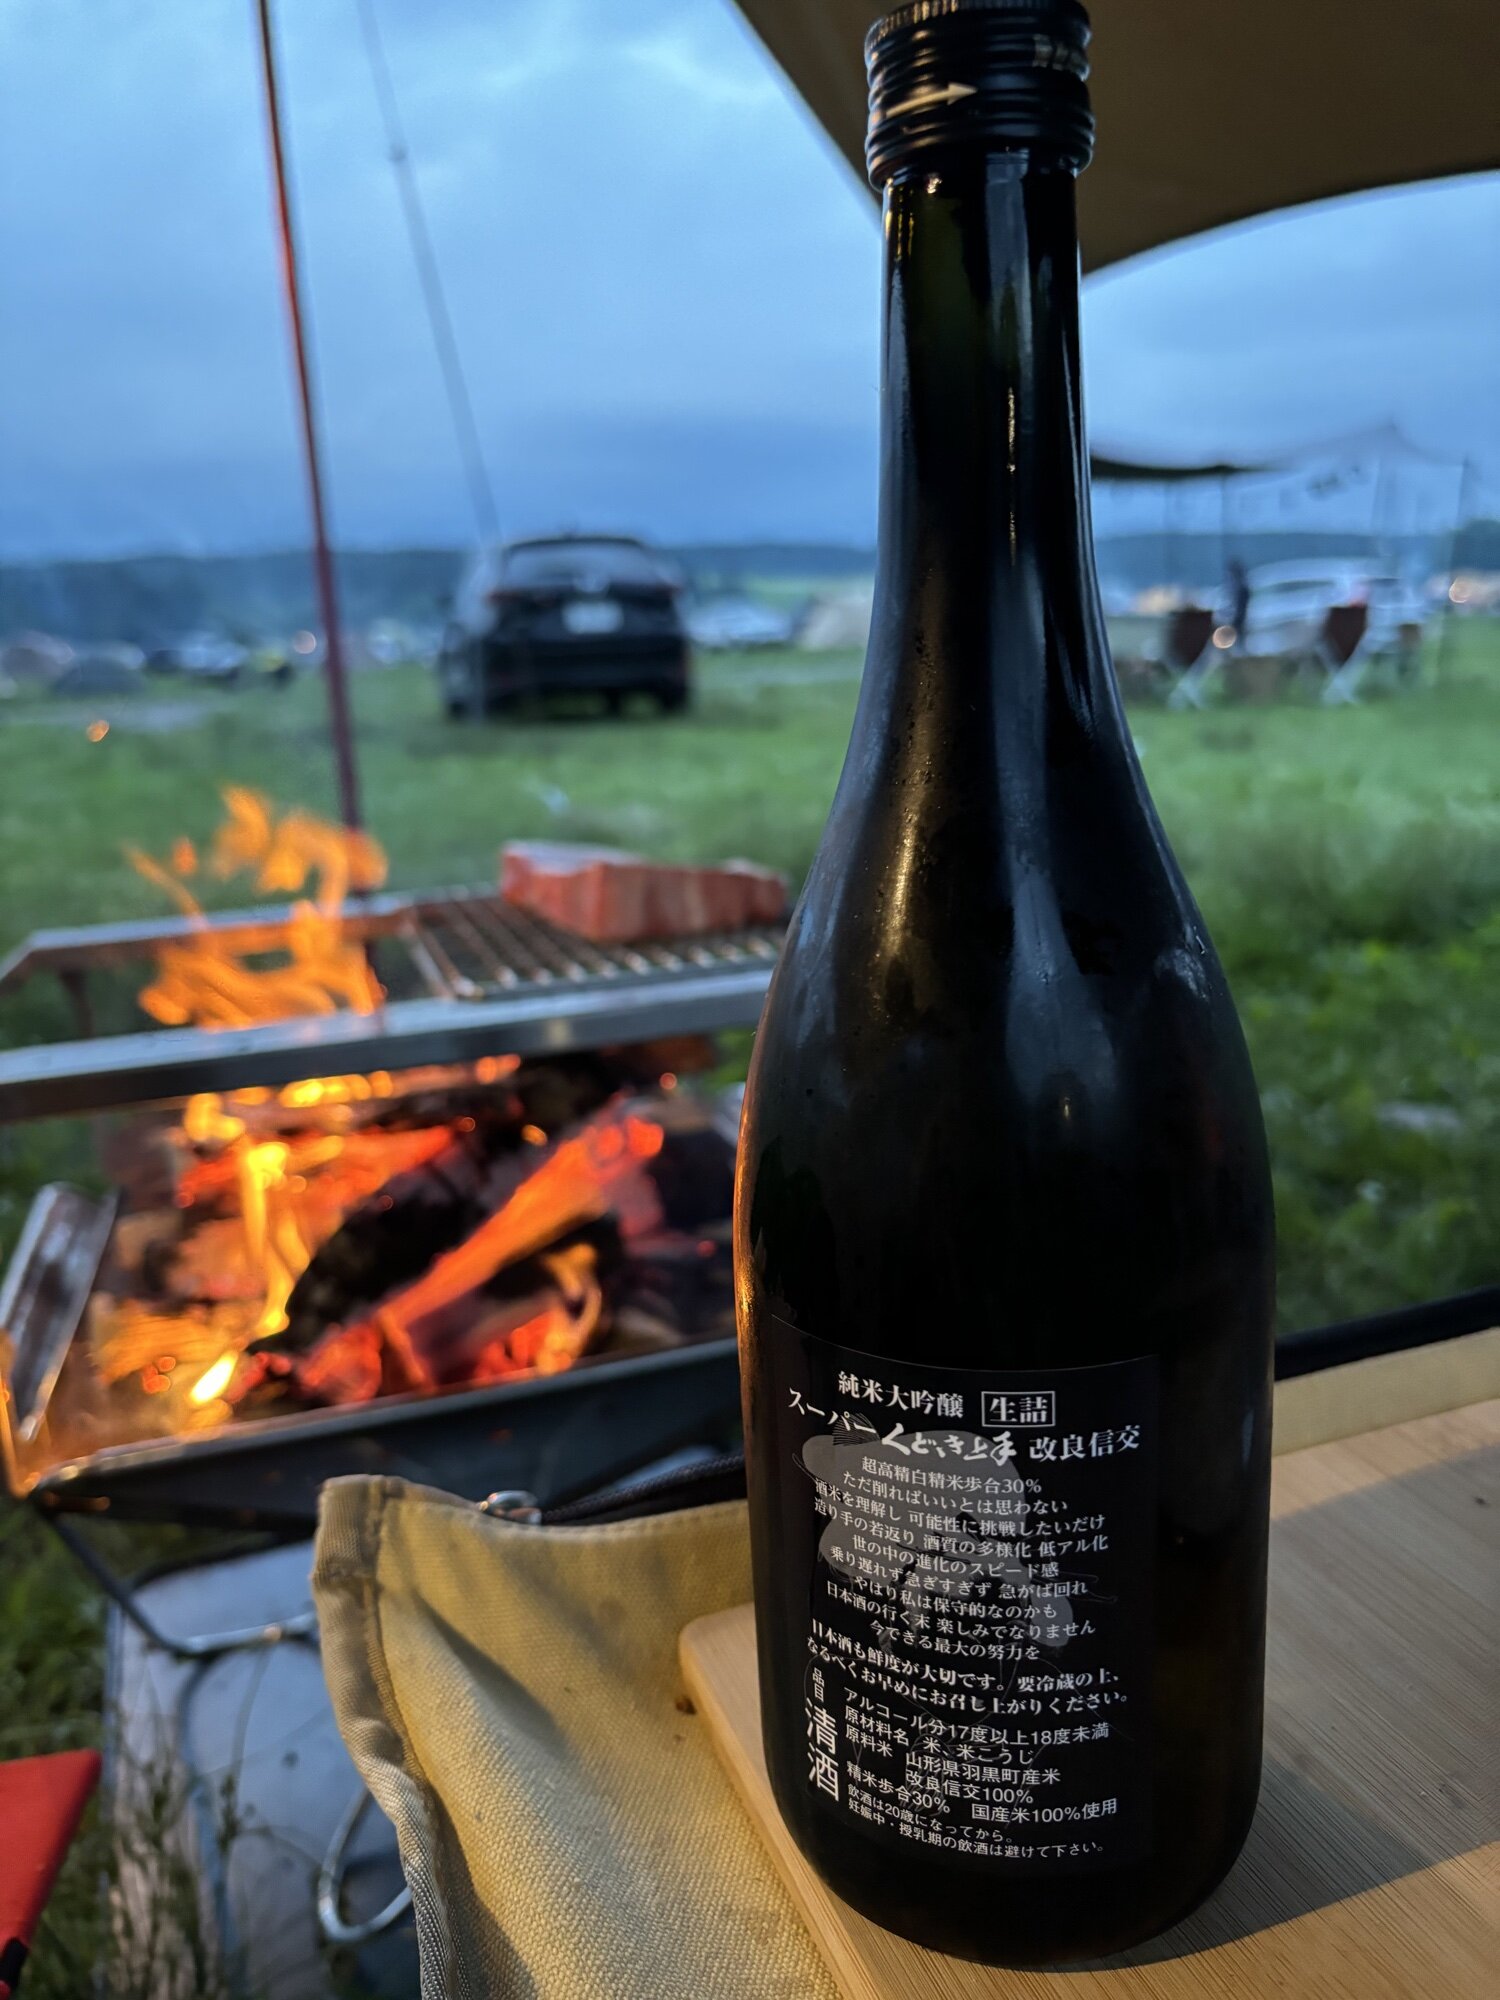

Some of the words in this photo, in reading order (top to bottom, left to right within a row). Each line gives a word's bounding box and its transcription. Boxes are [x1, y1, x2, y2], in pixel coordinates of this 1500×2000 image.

[838, 1370, 964, 1419] 純米大吟醸
[989, 1396, 1048, 1424] 生詰
[1029, 1424, 1141, 1463] 改良信交
[843, 1471, 1068, 1516] ただ削ればいいとは思わない
[861, 1456, 1042, 1495] 超高精白精米歩合30%
[814, 1497, 914, 1545] 造り手の若返り
[923, 1533, 1032, 1559] 酒質の多様化
[1038, 1534, 1109, 1558] 低アル化
[815, 1477, 901, 1521] 酒米を理解し
[908, 1510, 1106, 1537] 可能性に挑戦したいだけ
[852, 1534, 1060, 1579] 世の中の進化のスピード感
[827, 1580, 930, 1630] 日本酒の行く末
[936, 1617, 1096, 1640] 楽しみでなりません
[854, 1576, 1057, 1619] やはり私は保守的なのかも
[998, 1580, 1088, 1600] 急がば回れ
[870, 1619, 1040, 1661] 今できる最大の努力を
[812, 1667, 825, 1703] 品目
[843, 1686, 1109, 1746] アルコール分17度以上18度未満
[845, 1704, 909, 1747] 原材料名
[805, 1697, 838, 1802] 清酒
[845, 1723, 893, 1758] 原料米
[905, 1751, 1061, 1786] 山形県羽黒町産米
[846, 1760, 951, 1815] 精米歩合30%
[971, 1797, 1118, 1825] 国産米100%使用
[905, 1769, 1034, 1804] 改良信交100%
